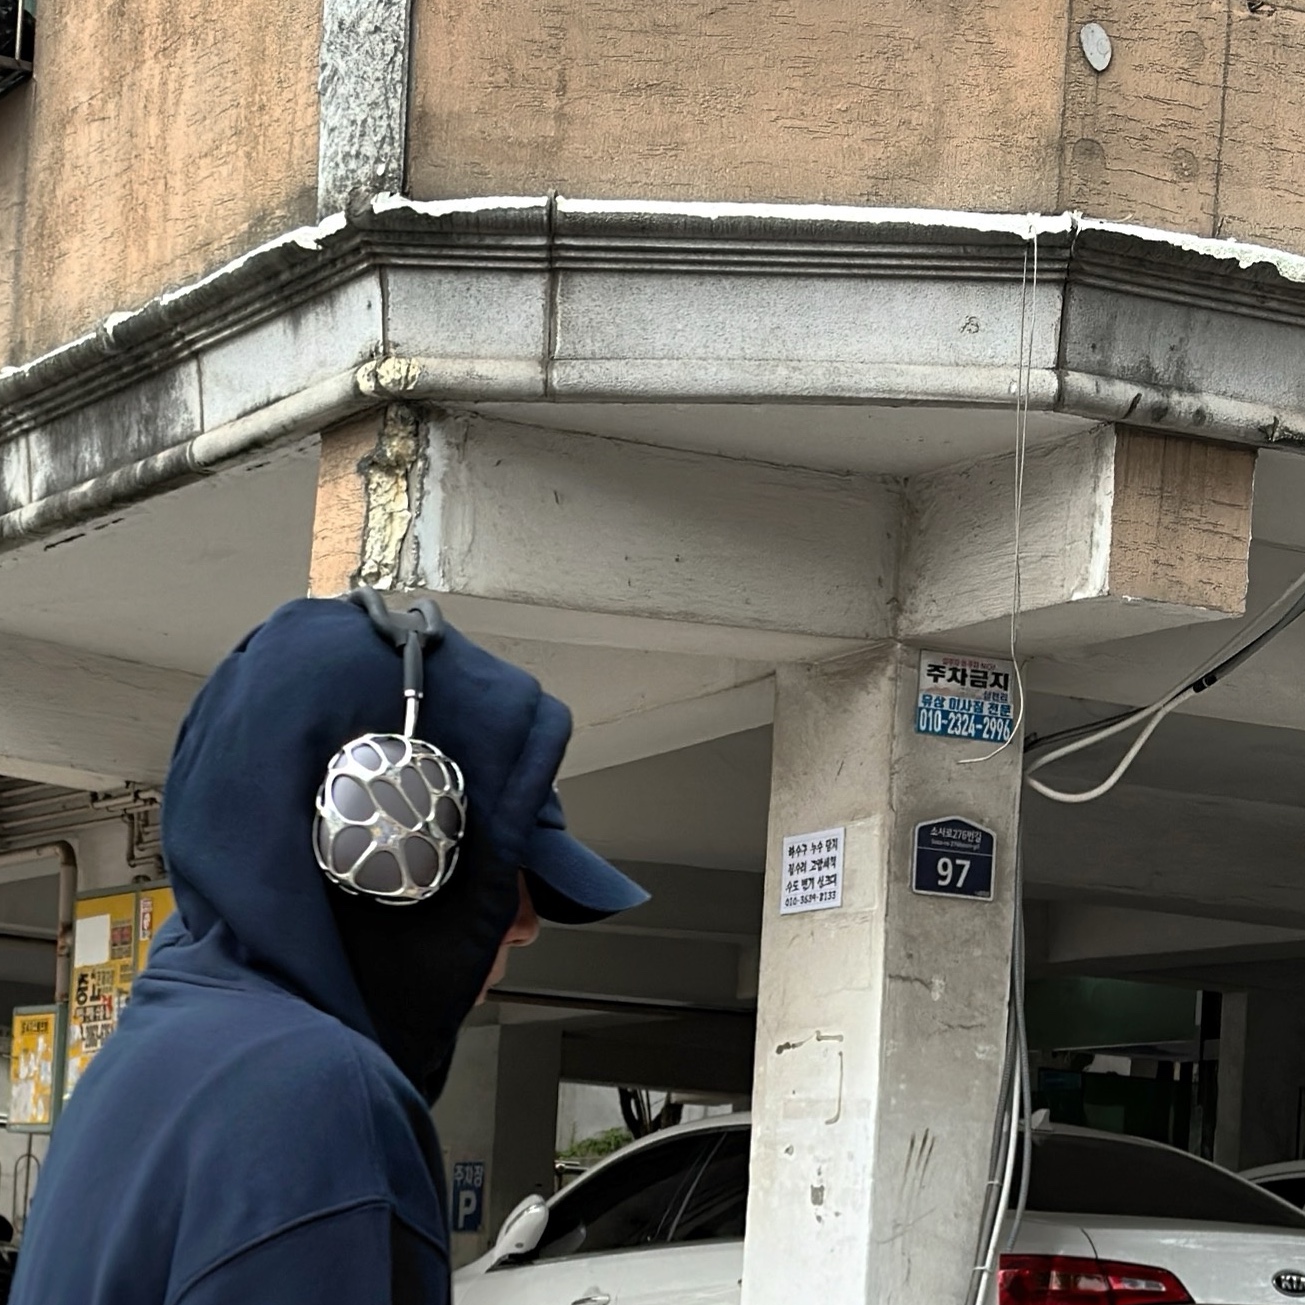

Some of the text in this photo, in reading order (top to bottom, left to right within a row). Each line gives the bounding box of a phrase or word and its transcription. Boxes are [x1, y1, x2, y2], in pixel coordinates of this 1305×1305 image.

[926, 663, 1010, 692] 주차금지
[919, 708, 1011, 741] 010-2324-2996
[785, 880, 799, 894] 수도
[937, 857, 971, 888] 97
[454, 1164, 484, 1188] 주차장
[458, 1190, 477, 1230] P
